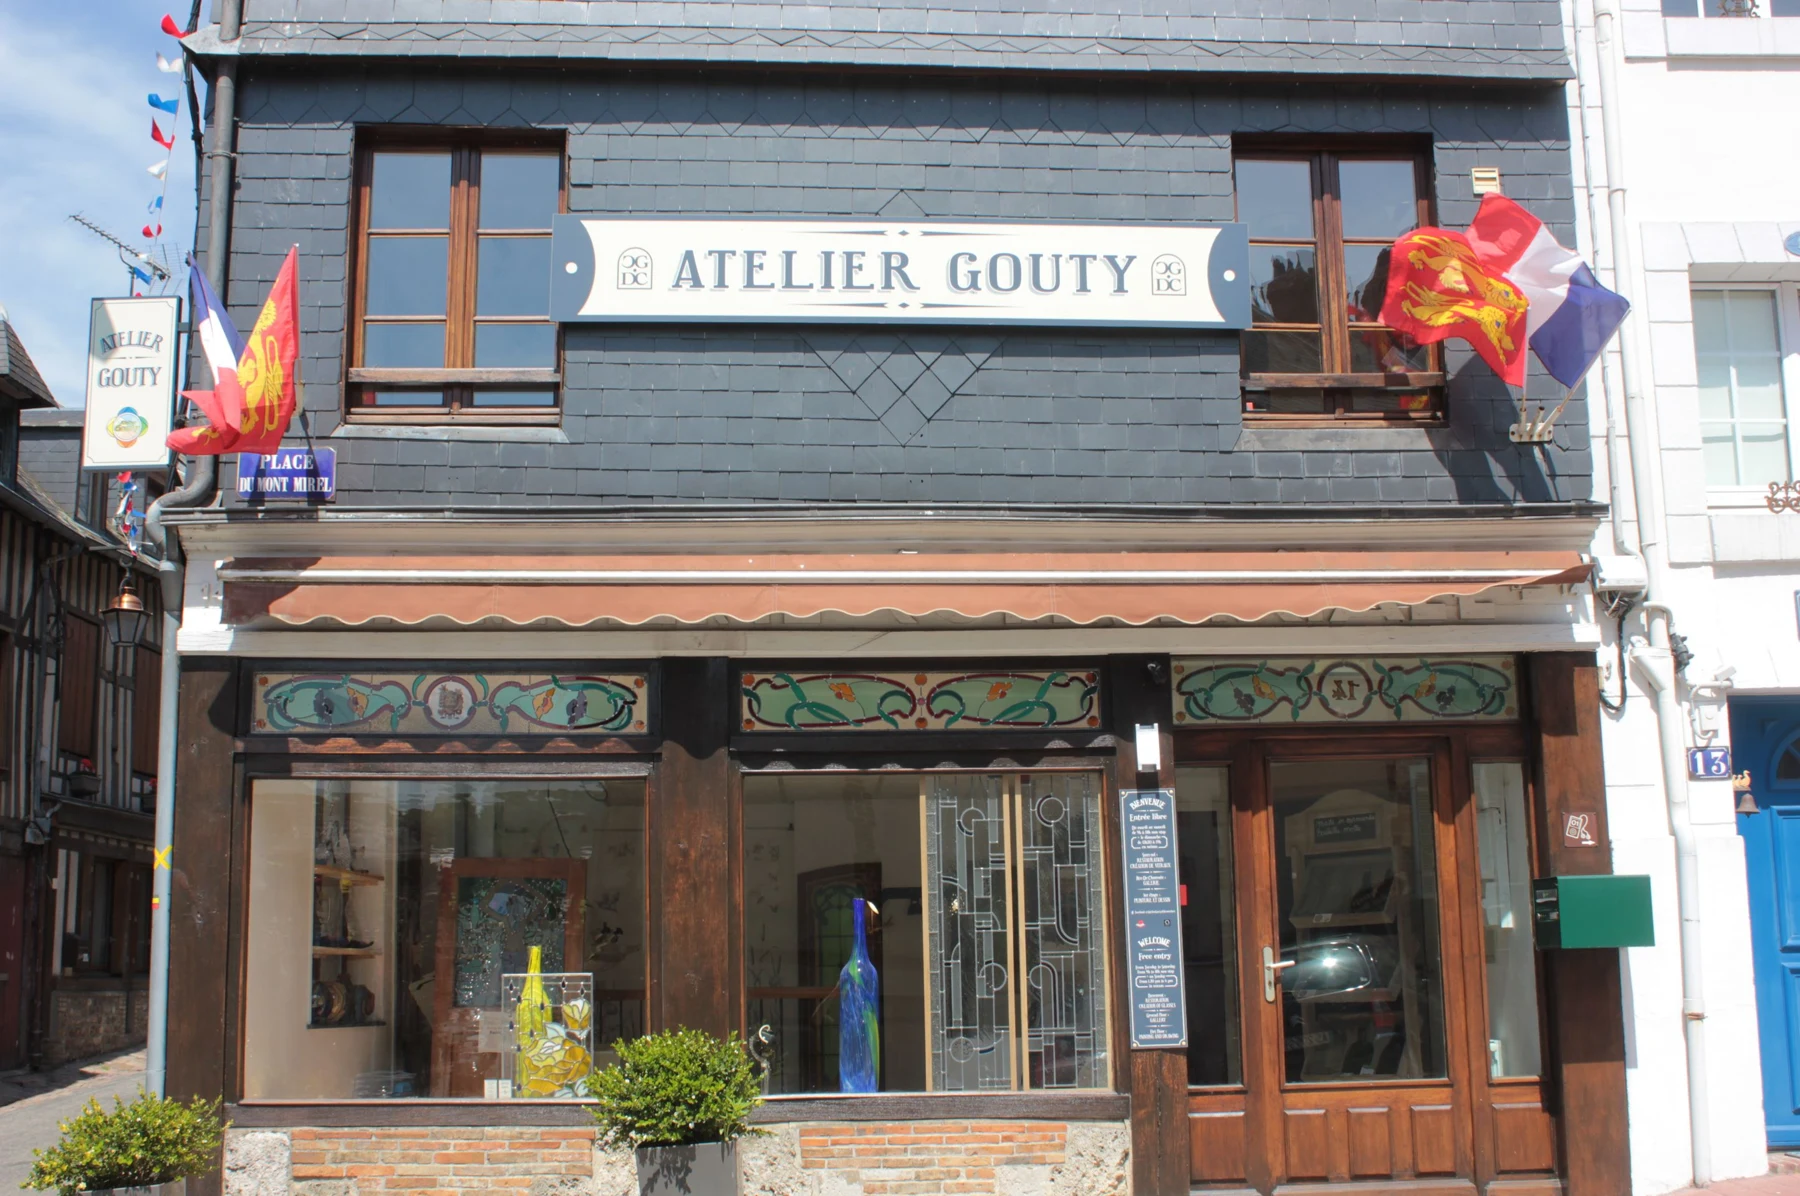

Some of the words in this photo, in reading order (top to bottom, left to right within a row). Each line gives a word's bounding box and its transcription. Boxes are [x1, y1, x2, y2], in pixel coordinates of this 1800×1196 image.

[669, 249, 921, 293] ATELIER
[946, 252, 1138, 297] GOUTY
[100, 331, 164, 353] ATELIER
[98, 366, 162, 387] GOUTY
[260, 454, 314, 470] PLACE
[239, 476, 255, 493] DU
[257, 476, 289, 493] MONT
[293, 476, 332, 493] MIREL
[1693, 751, 1727, 776] 13
[1129, 797, 1166, 810] BIENVENUE
[1129, 813, 1151, 822] Entrée
[1138, 936, 1171, 948] WELCOME
[1138, 952, 1152, 961] Free
[1154, 952, 1172, 960] entry
